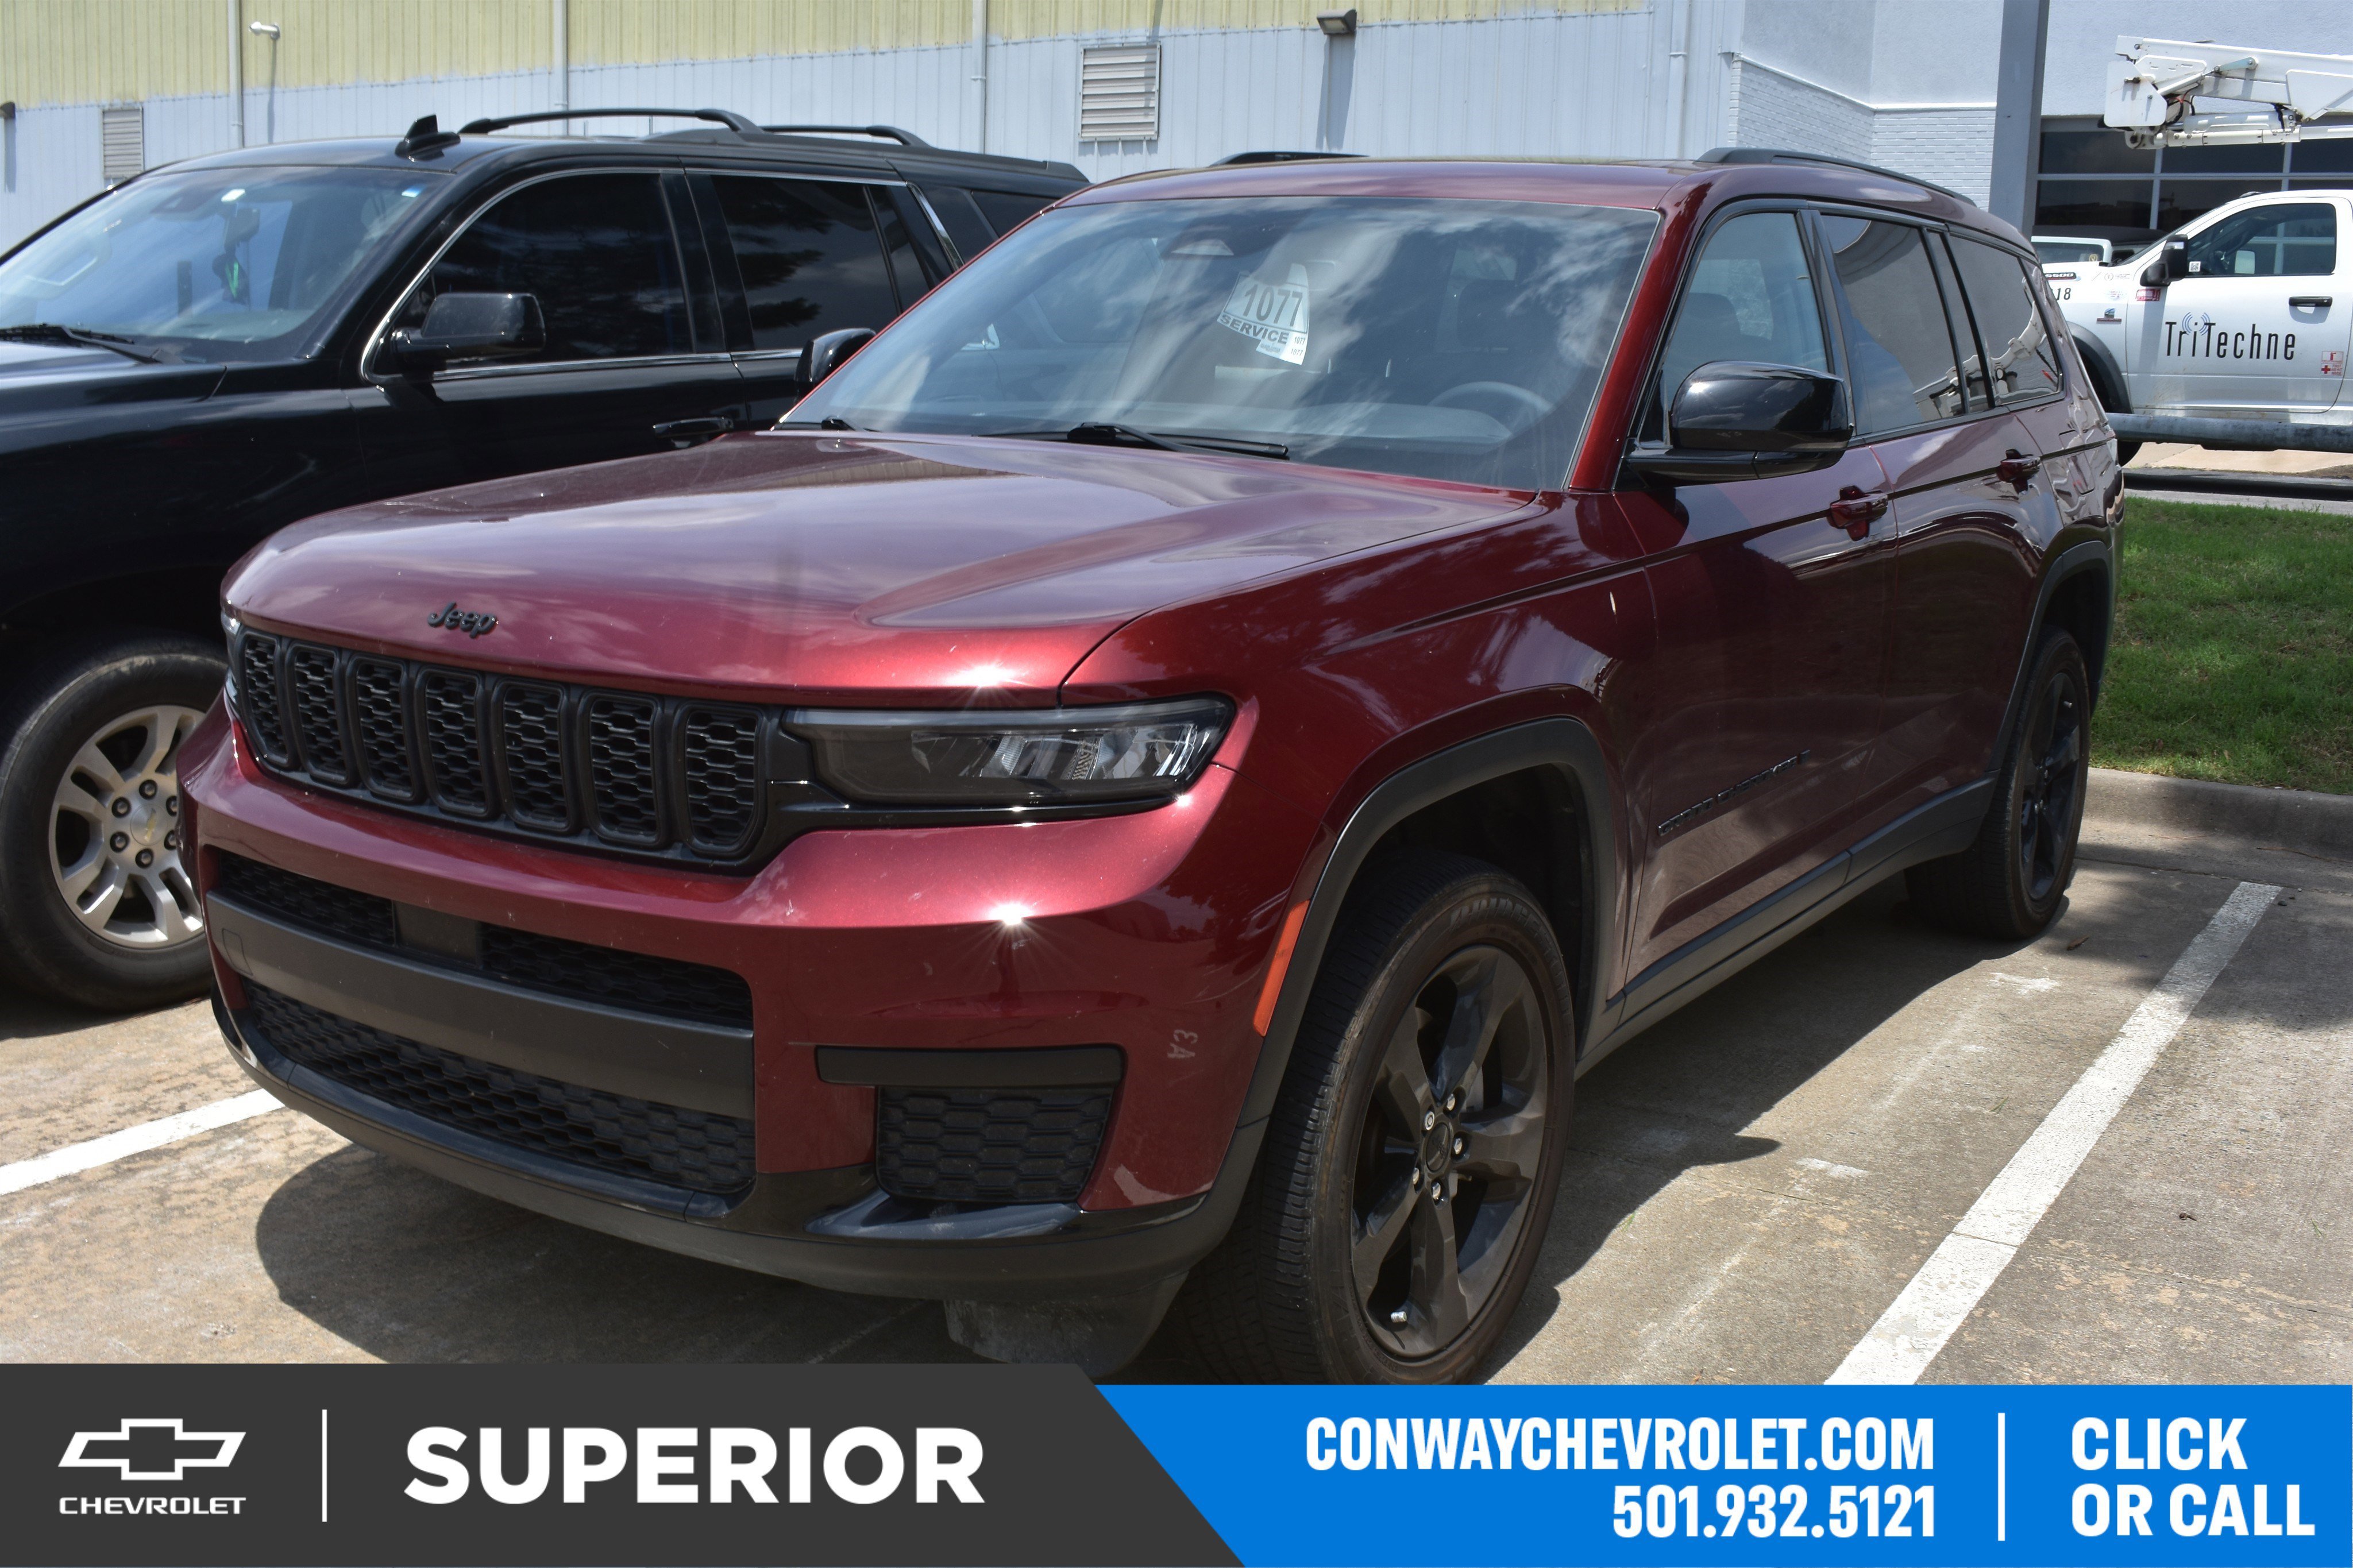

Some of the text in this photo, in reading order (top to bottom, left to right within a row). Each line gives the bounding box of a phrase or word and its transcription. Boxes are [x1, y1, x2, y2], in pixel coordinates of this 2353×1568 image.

[1243, 284, 1303, 327] 1077
[2051, 287, 2072, 300] 18
[1220, 315, 1290, 345] SERVICE
[1294, 337, 1306, 345] 1077
[2165, 321, 2296, 361] TriTechne
[1291, 348, 1303, 357] 1077
[427, 601, 497, 639] Jeep
